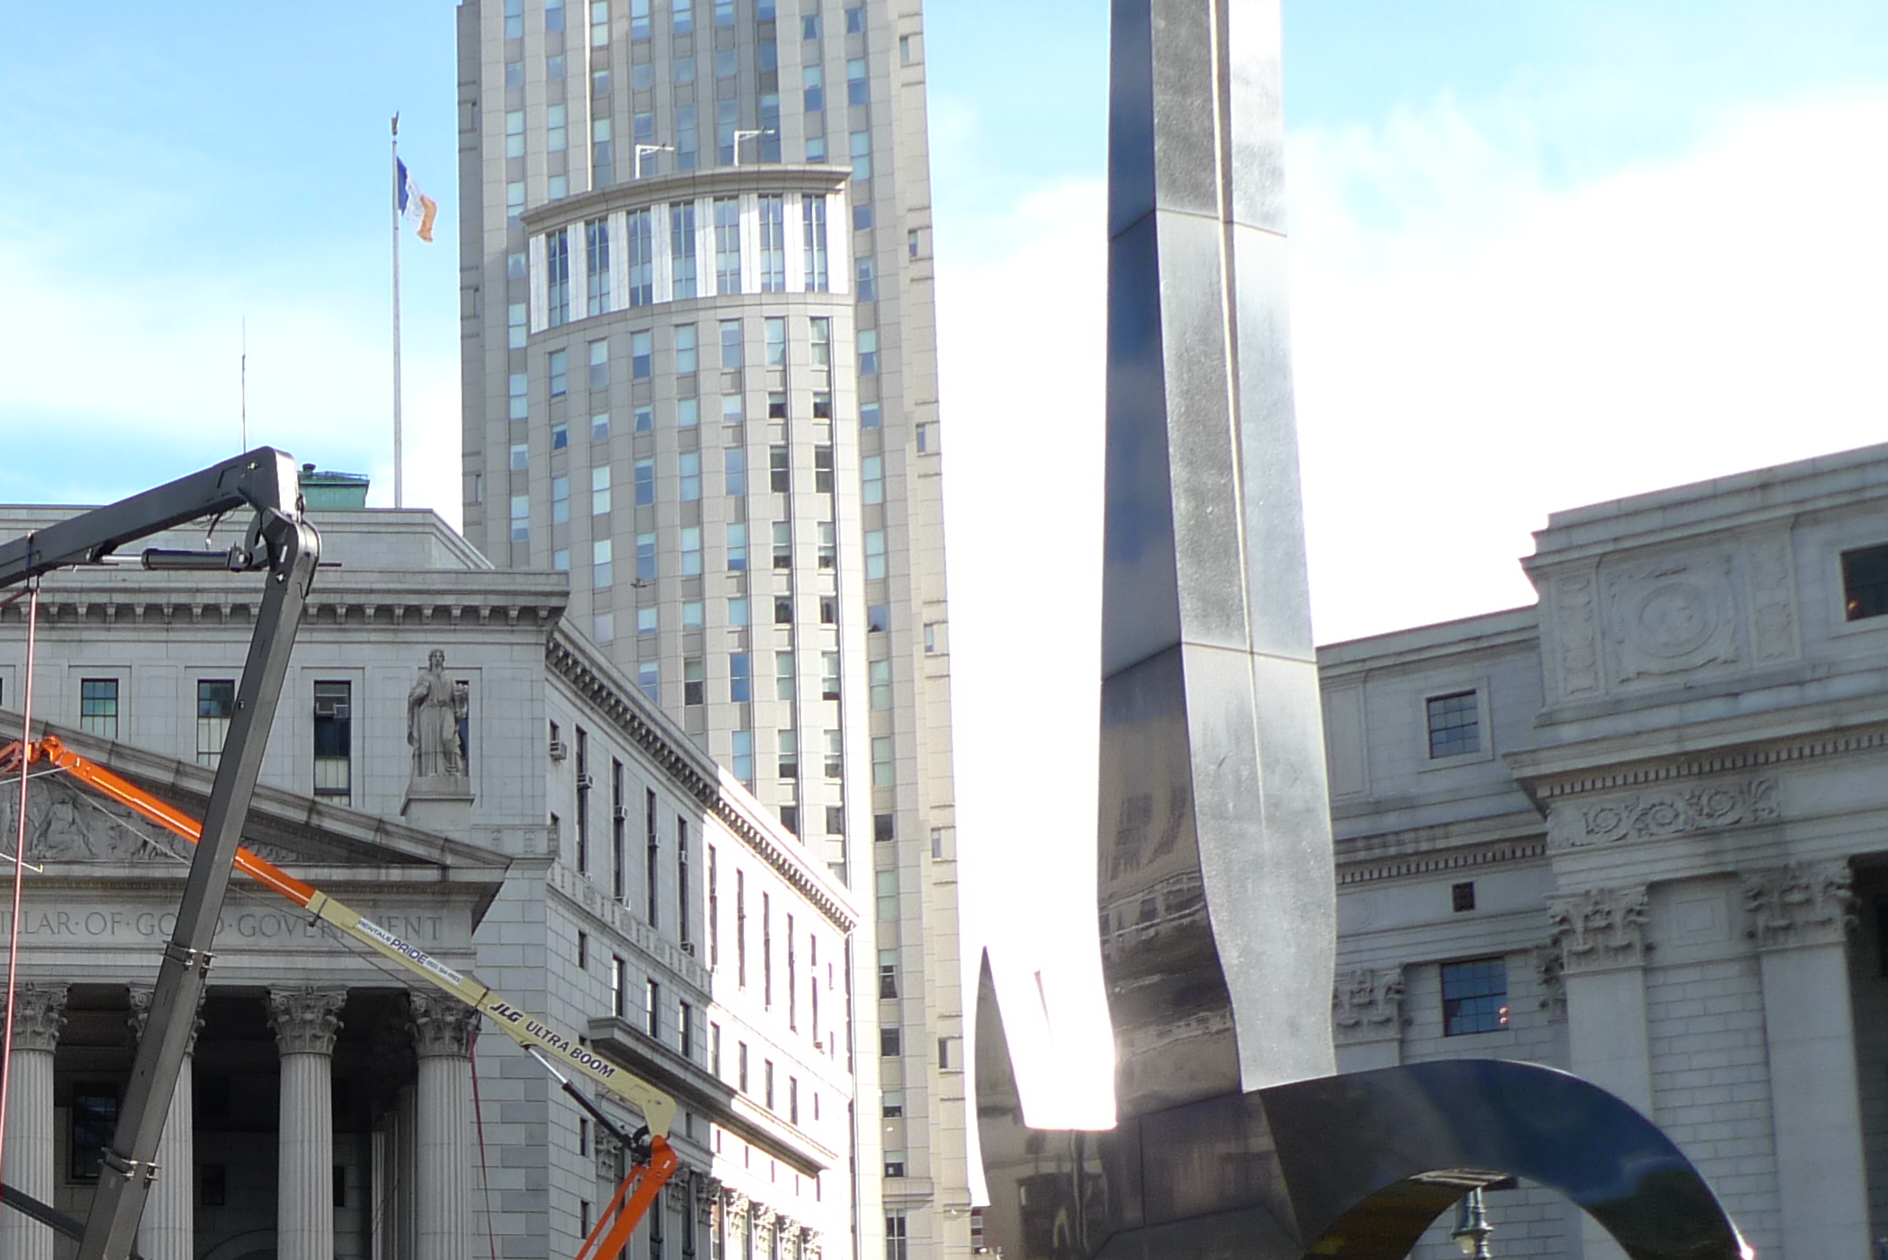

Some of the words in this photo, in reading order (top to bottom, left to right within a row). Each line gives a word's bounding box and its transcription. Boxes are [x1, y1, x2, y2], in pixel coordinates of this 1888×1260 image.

[84, 911, 123, 935] OF
[136, 912, 224, 937] GO
[237, 913, 443, 940] GOVERENT
[391, 938, 429, 966] PRIDE
[488, 1002, 524, 1023] JLG
[525, 1020, 570, 1054] ULTRA
[569, 1046, 616, 1079] BOOM
